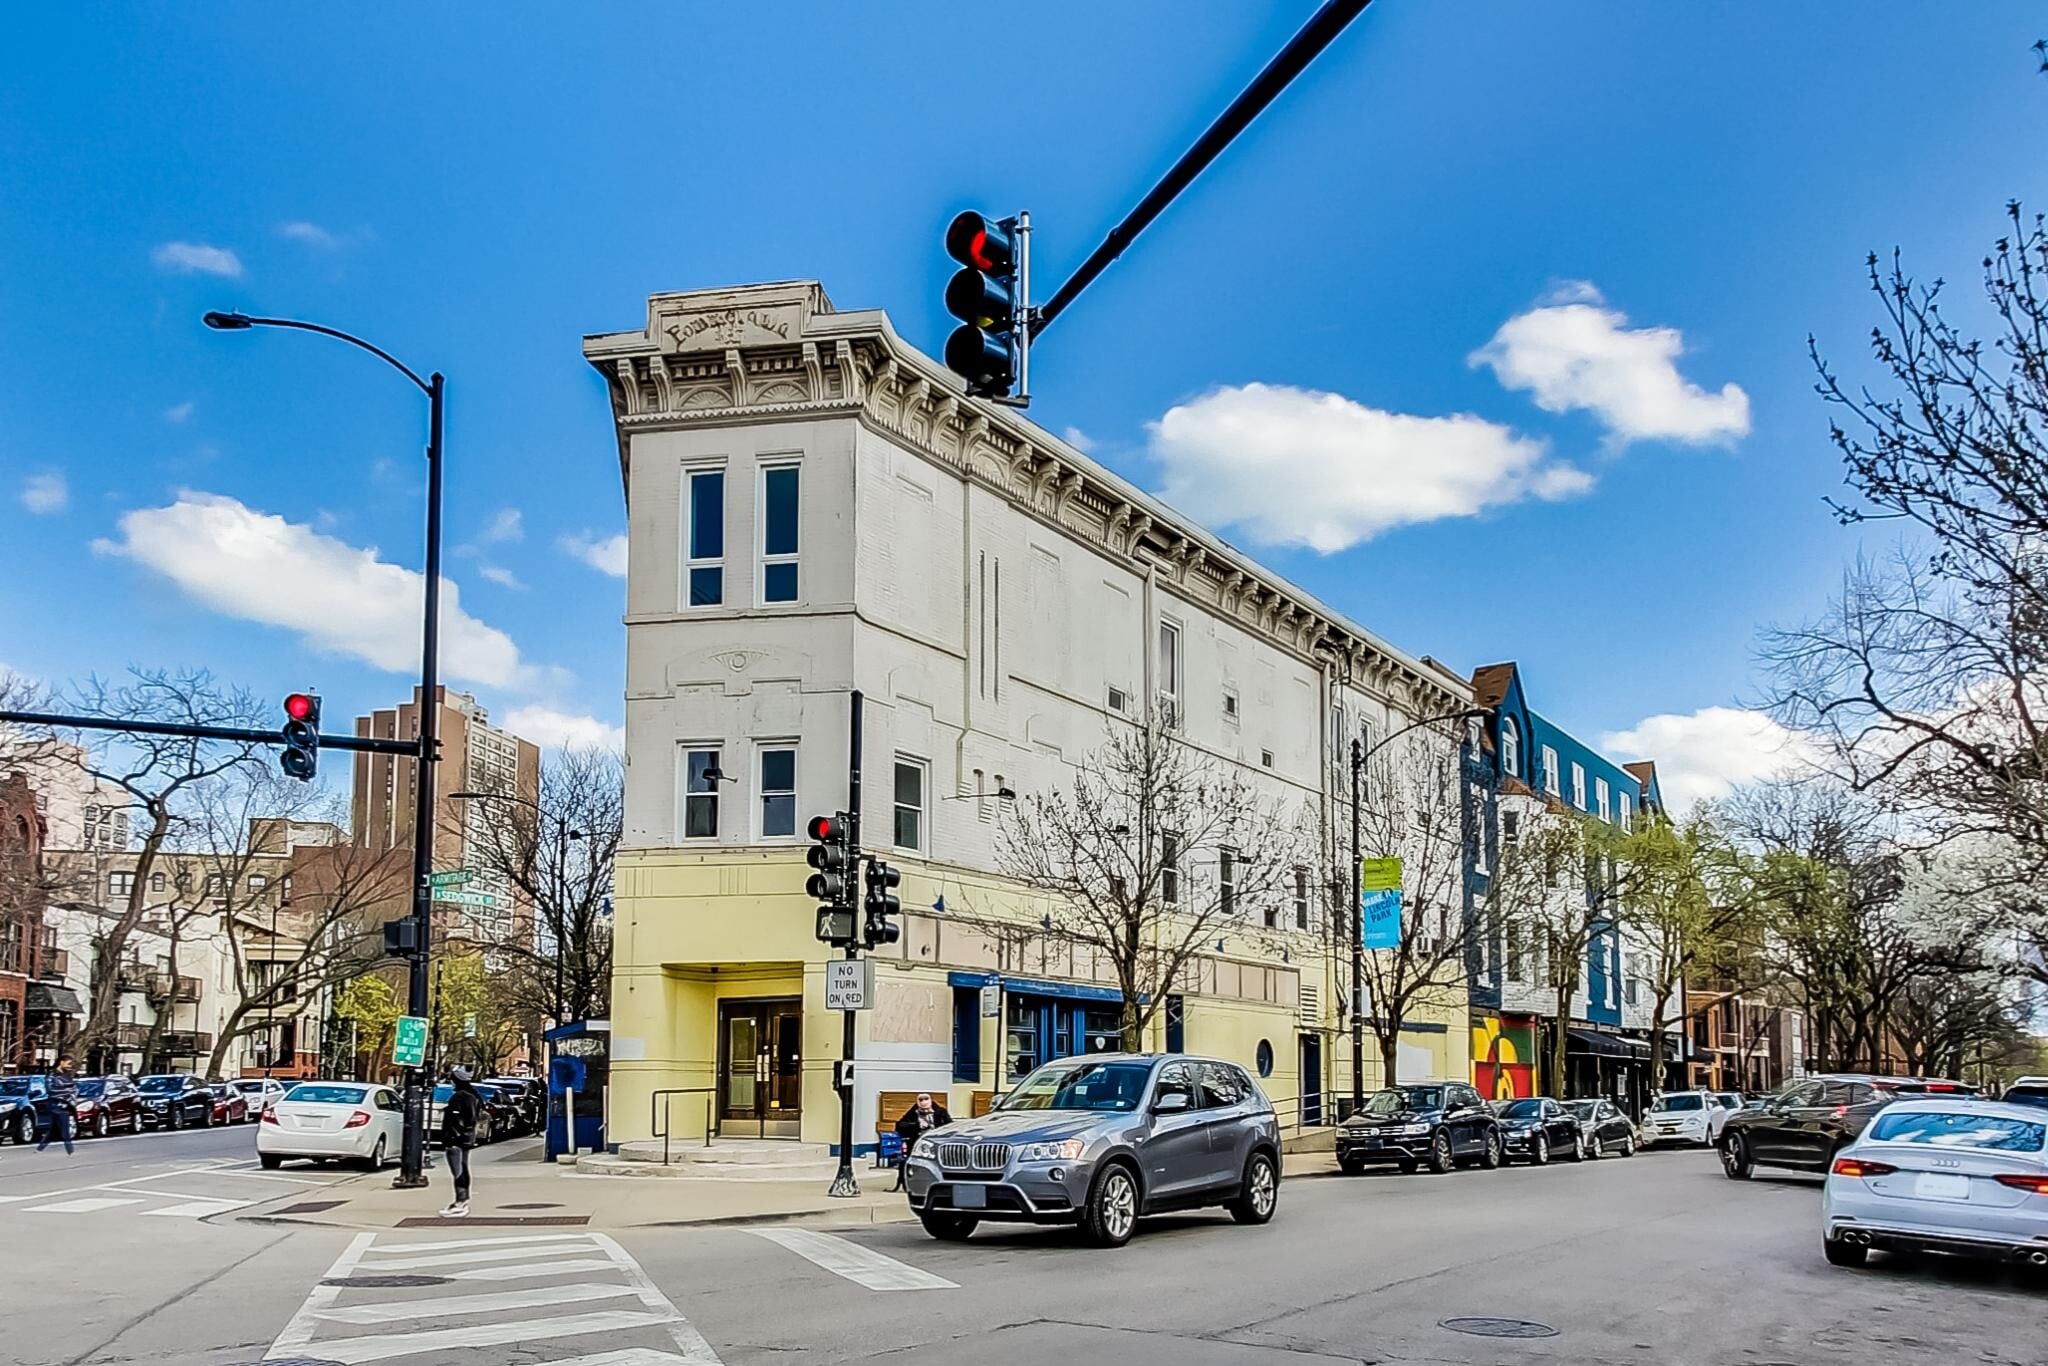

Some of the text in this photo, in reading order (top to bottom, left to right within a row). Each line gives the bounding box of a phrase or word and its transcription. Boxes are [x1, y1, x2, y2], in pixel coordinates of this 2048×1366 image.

[1371, 909, 1392, 923] PARK
[838, 966, 853, 976] NO
[834, 980, 858, 989] TURN
[829, 993, 862, 1003] ON RED
